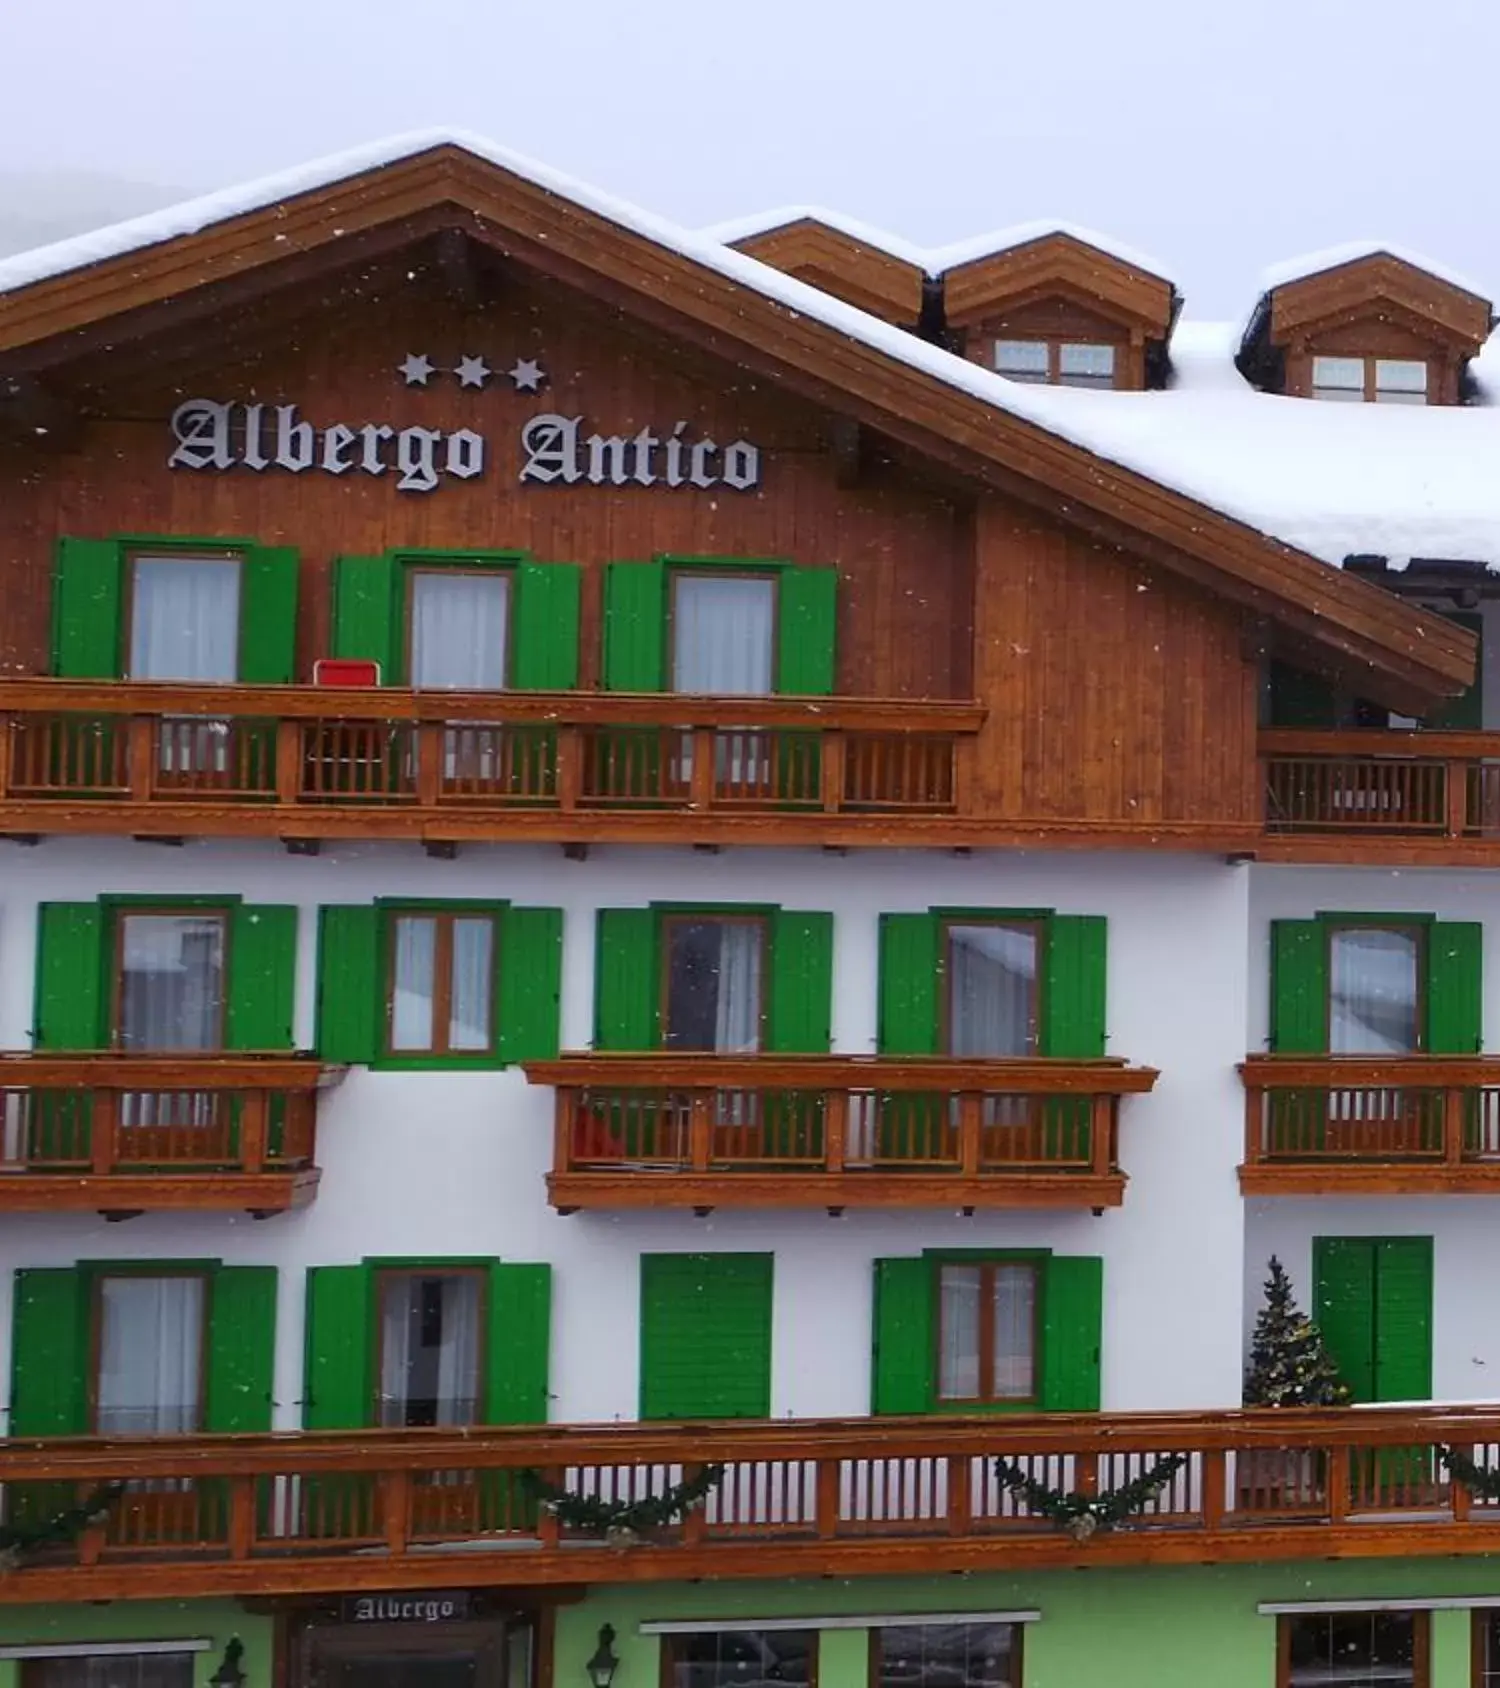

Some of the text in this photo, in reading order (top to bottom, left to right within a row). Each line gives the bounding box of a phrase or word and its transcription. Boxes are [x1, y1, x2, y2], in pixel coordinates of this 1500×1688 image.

[168, 399, 759, 491] Albergo Antico
[355, 1598, 454, 1621] Albergo
